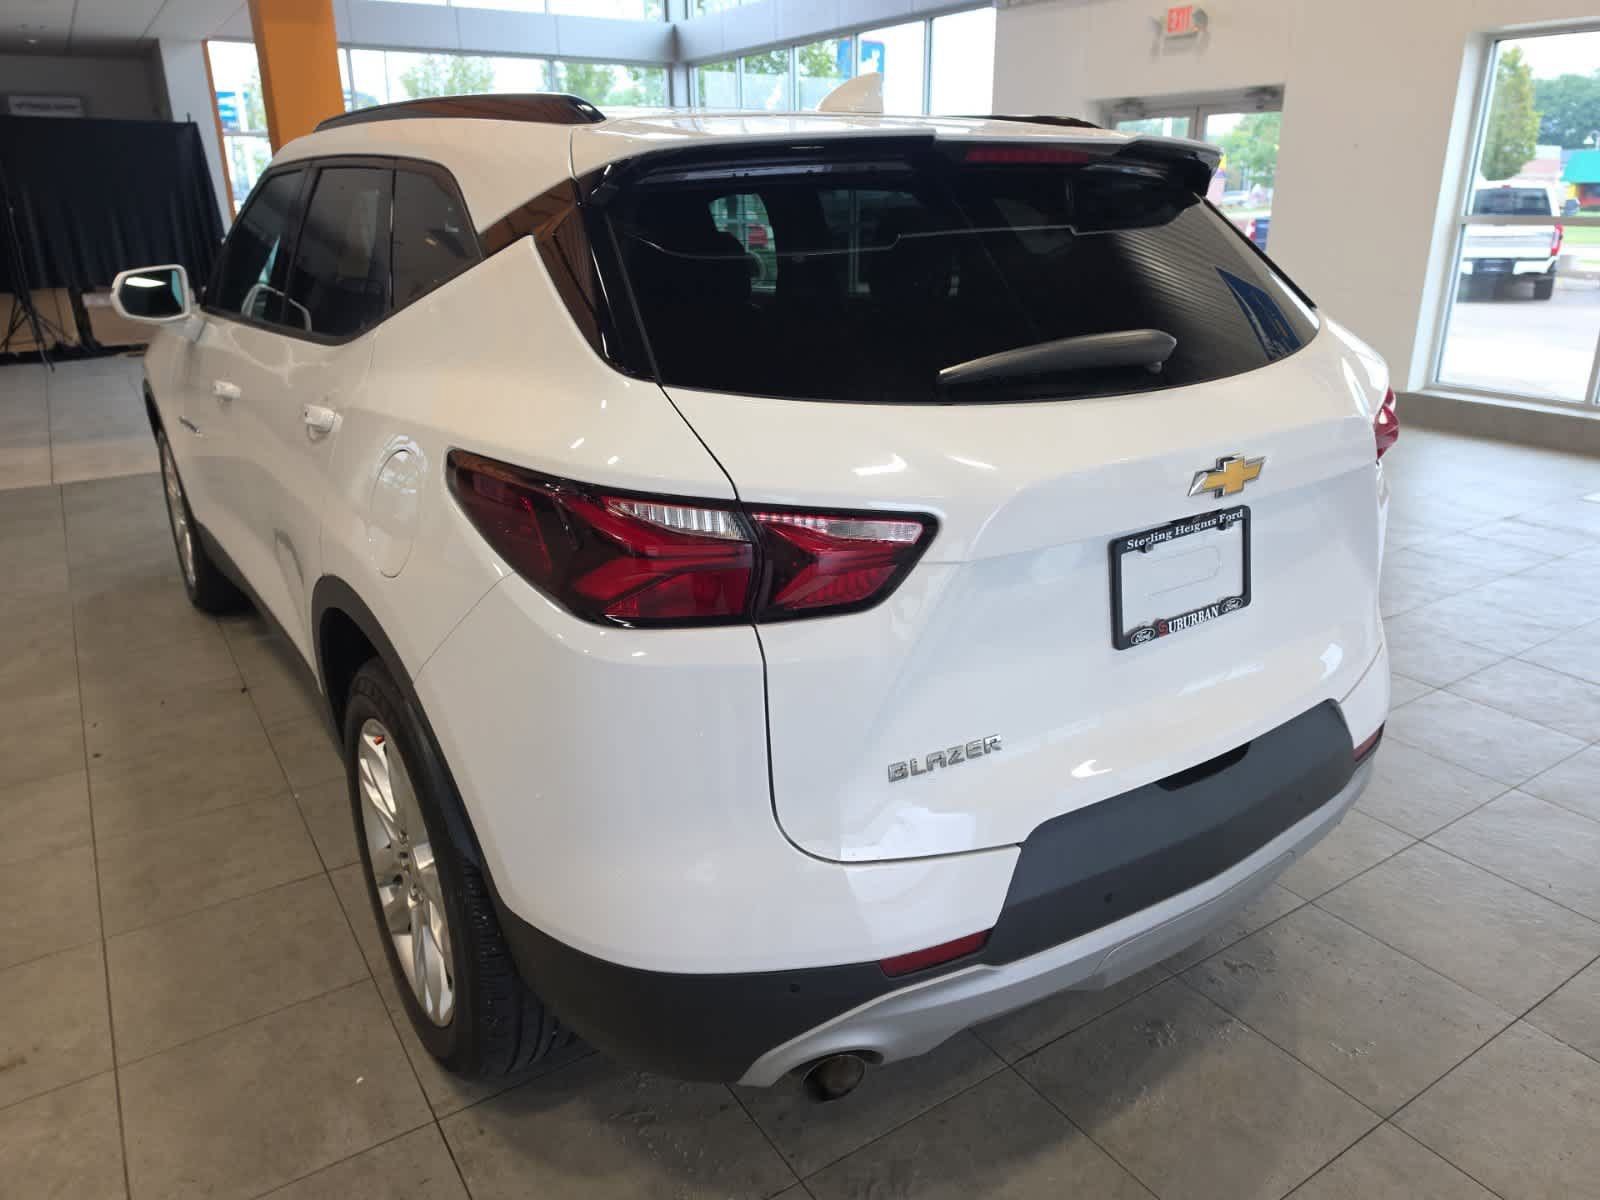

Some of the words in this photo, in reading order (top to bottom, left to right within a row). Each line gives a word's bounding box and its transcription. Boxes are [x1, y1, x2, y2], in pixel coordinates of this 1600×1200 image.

[1168, 8, 1191, 31] EXIT
[1127, 532, 1173, 550] Sterling
[1219, 509, 1244, 524] Ford
[1158, 605, 1220, 637] SUBURBAN
[888, 734, 1002, 783] BLAZER
